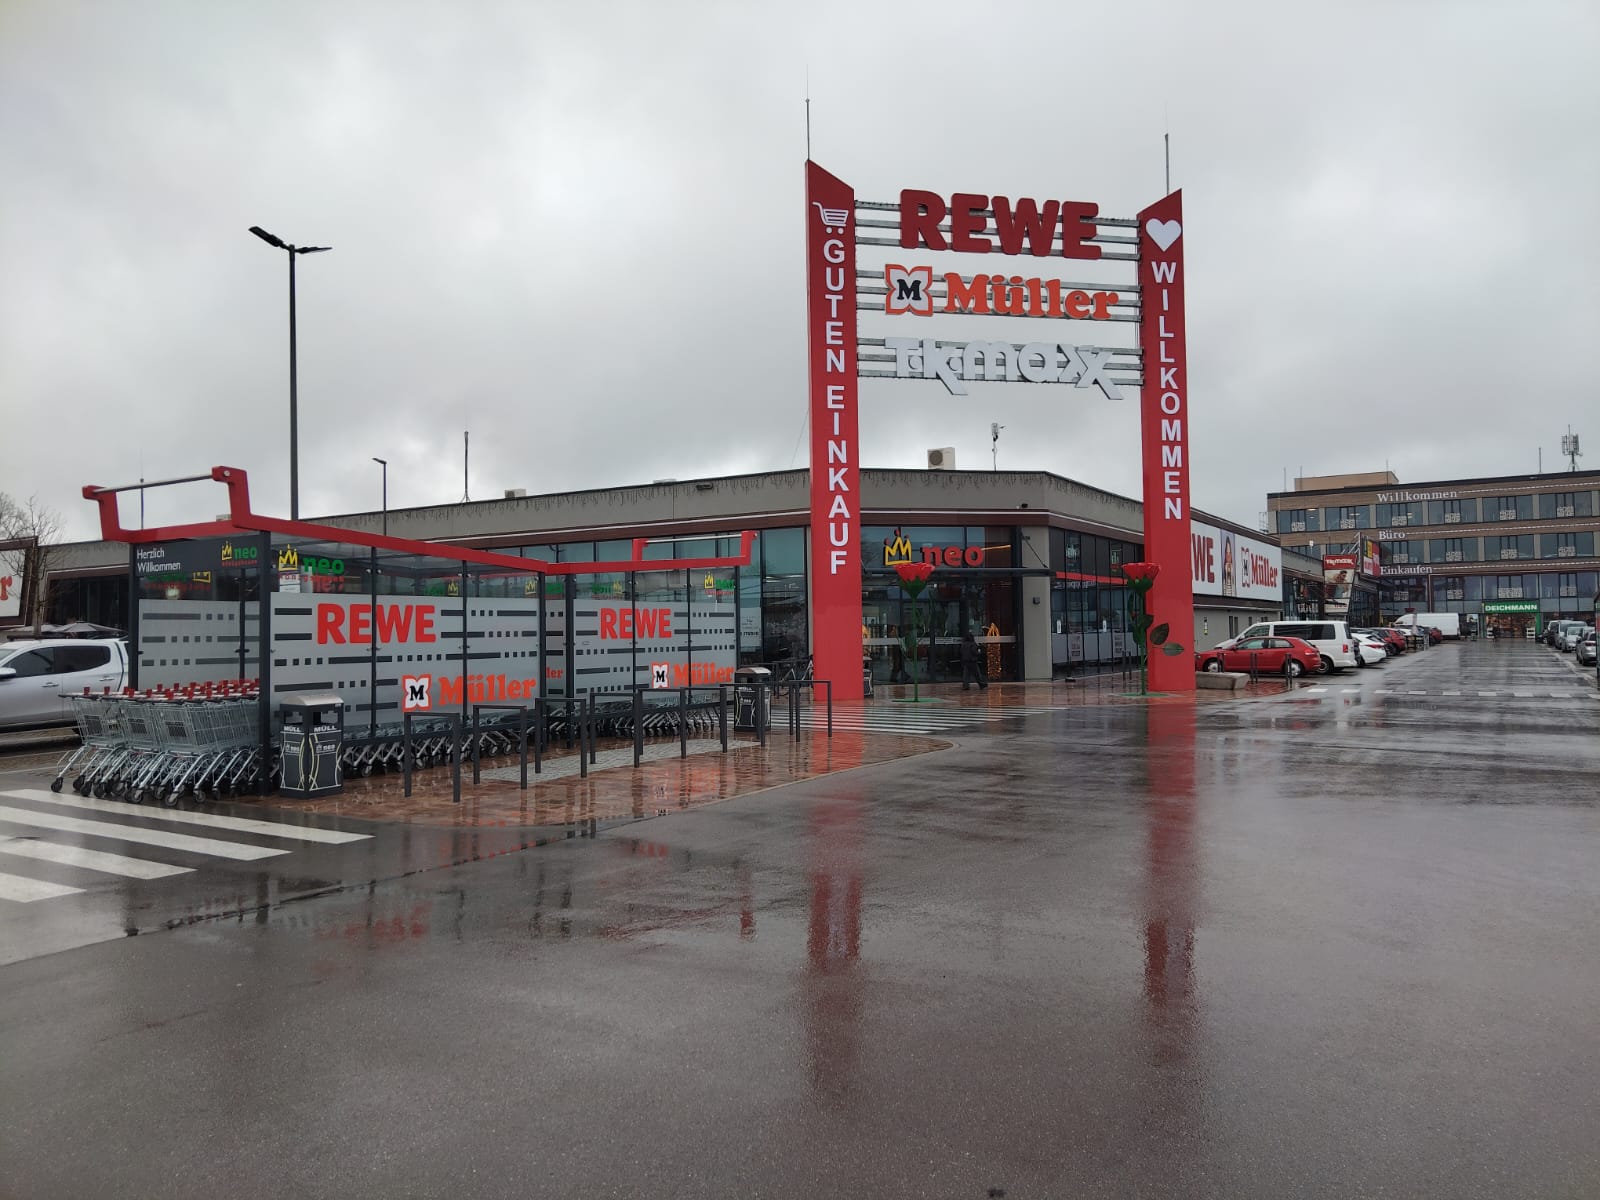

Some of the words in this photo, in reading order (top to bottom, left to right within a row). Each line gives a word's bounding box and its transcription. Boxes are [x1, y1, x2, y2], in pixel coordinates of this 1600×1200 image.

[900, 189, 1102, 260] REWE
[823, 239, 846, 373] GUTEN
[897, 279, 921, 301] M
[943, 272, 1119, 320] Müller
[1151, 261, 1183, 520] WILLKOMMEN
[826, 385, 851, 575] EINKAUF
[1376, 491, 1458, 502] Willkommen
[1379, 528, 1406, 540] Büro
[136, 547, 165, 560] Herzlich
[137, 561, 181, 573] Willkommen
[233, 546, 258, 559] neo
[303, 557, 345, 575] neo
[921, 544, 985, 567] neo
[1191, 533, 1216, 584] WE
[1250, 553, 1278, 589] Müller
[1380, 564, 1433, 575] Einkaufen
[317, 603, 437, 645] REWE
[600, 607, 672, 639] REWE
[656, 670, 665, 683] M
[673, 662, 735, 688] Müller
[410, 685, 425, 701] M
[438, 673, 537, 707] Müller
[314, 725, 337, 733] MÜLL
